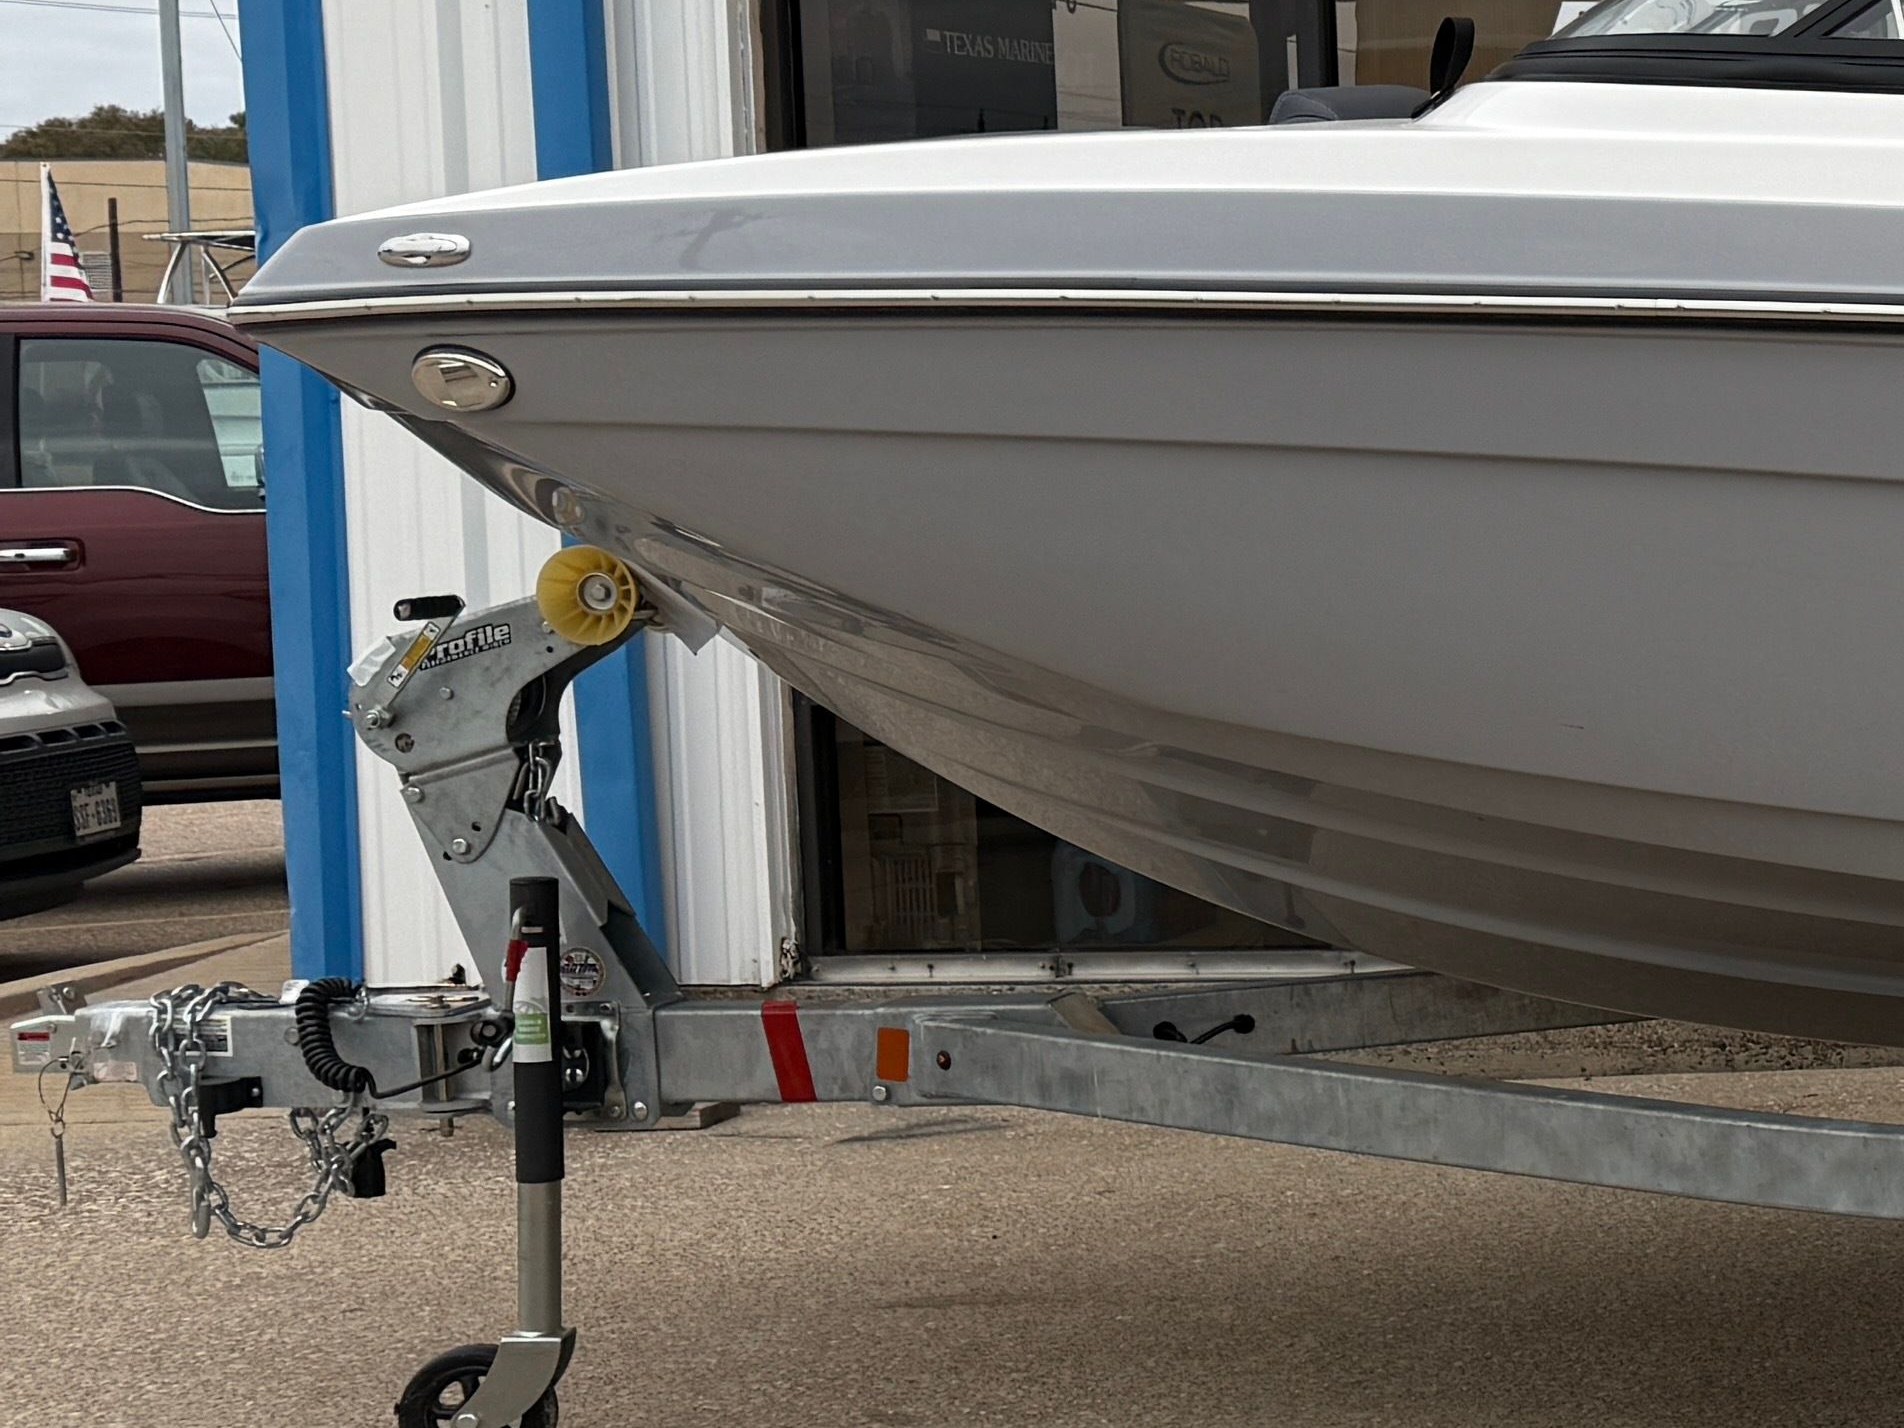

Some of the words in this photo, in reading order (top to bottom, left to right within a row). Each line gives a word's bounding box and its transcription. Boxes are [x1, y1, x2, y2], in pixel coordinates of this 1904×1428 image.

[943, 28, 994, 60] TEXAS
[997, 35, 1054, 67] MARINE
[428, 624, 511, 661] rofile
